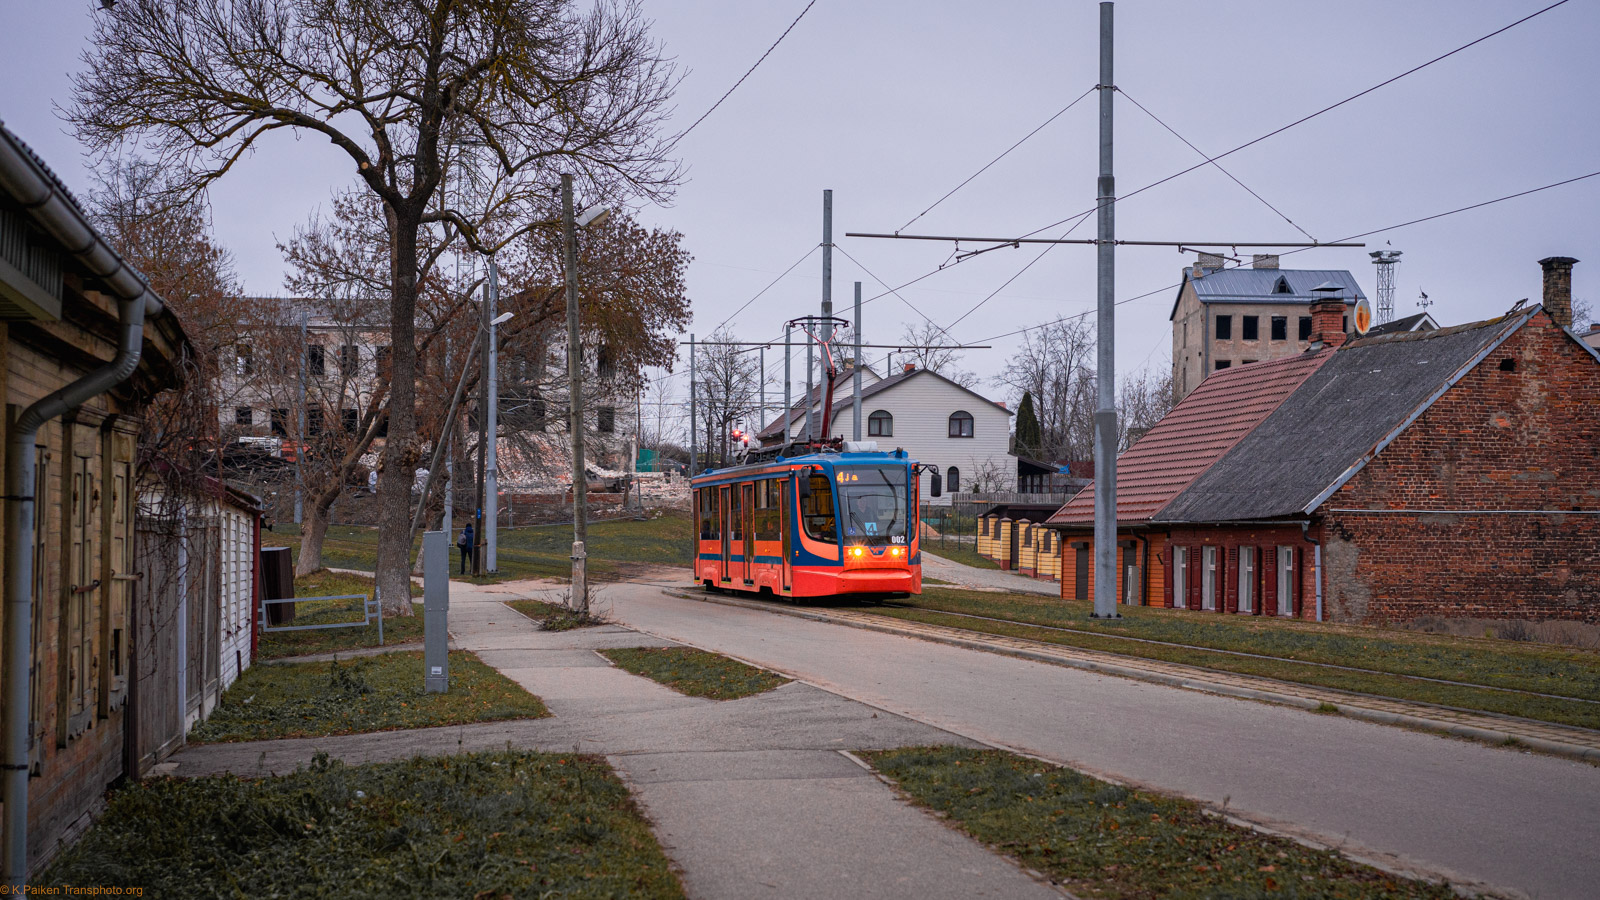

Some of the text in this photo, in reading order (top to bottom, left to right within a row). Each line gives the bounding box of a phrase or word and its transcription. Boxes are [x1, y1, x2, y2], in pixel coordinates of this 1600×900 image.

[836, 471, 844, 483] 4
[867, 523, 878, 535] 4
[891, 535, 905, 544] 002
